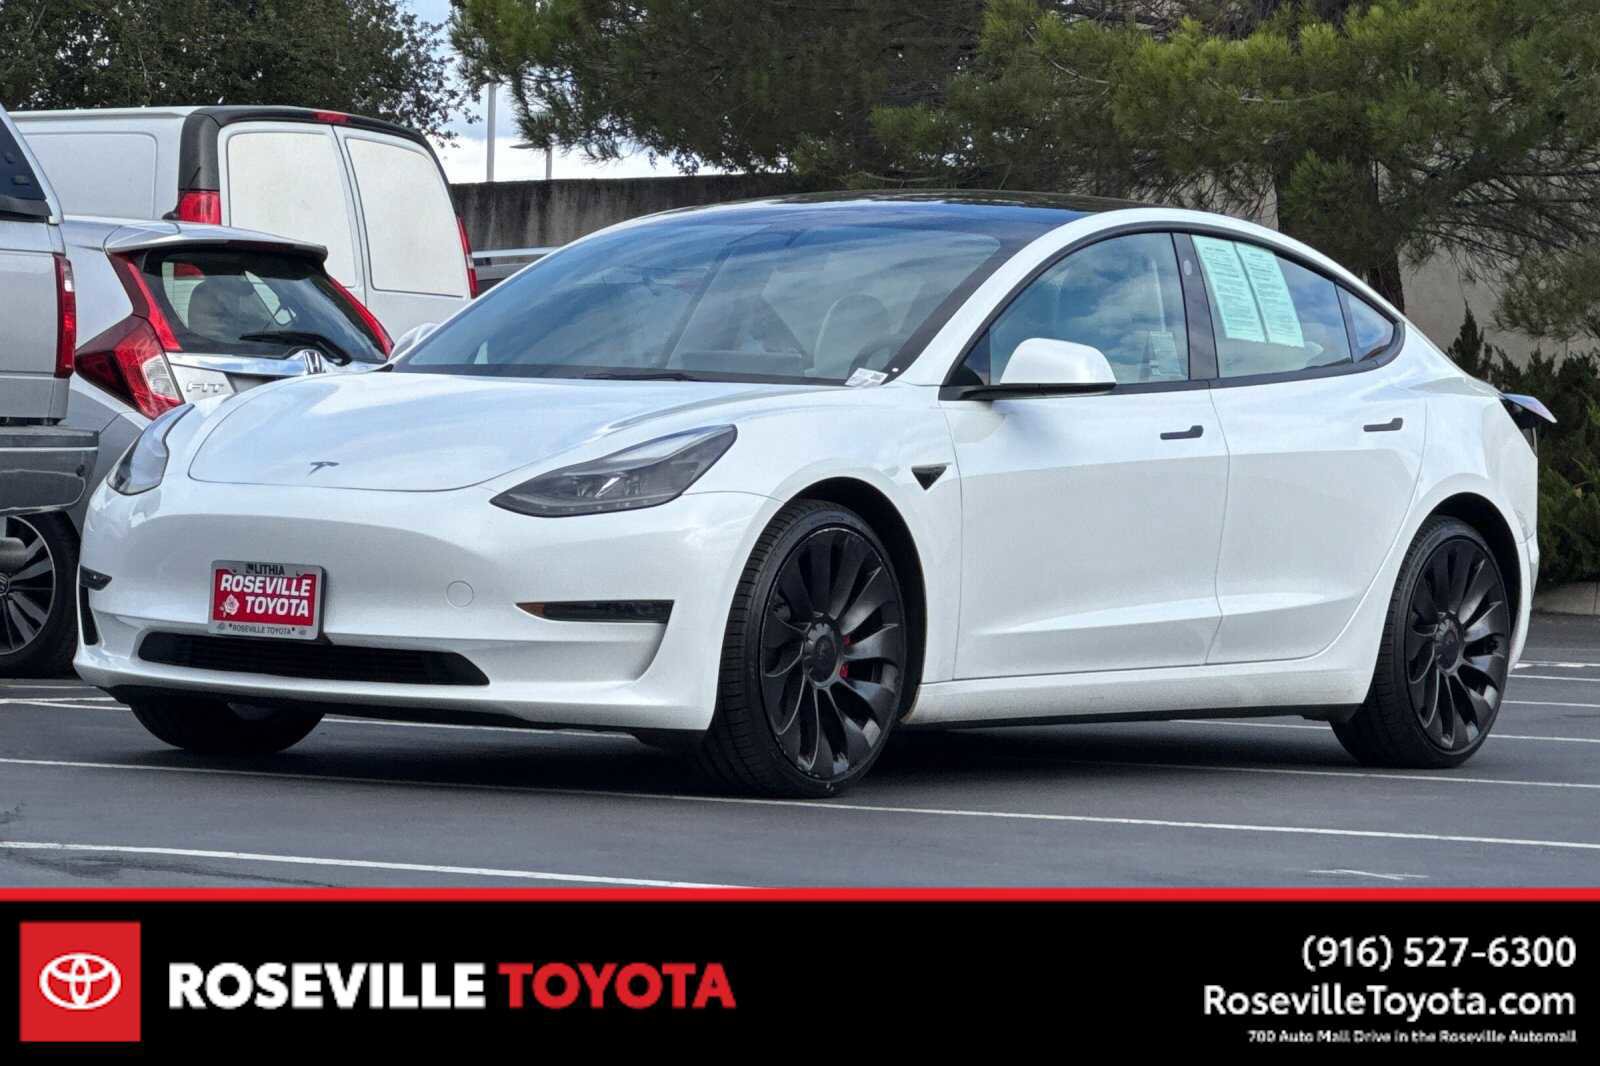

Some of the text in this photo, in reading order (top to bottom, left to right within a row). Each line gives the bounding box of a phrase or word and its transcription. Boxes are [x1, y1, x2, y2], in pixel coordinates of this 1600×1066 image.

[186, 382, 225, 393] FIT
[254, 563, 286, 575] LITHIA
[220, 574, 313, 597] ROSEVILLE
[245, 596, 310, 617] TOYOTA
[232, 624, 292, 635] ROSEVILLE TOYOTA
